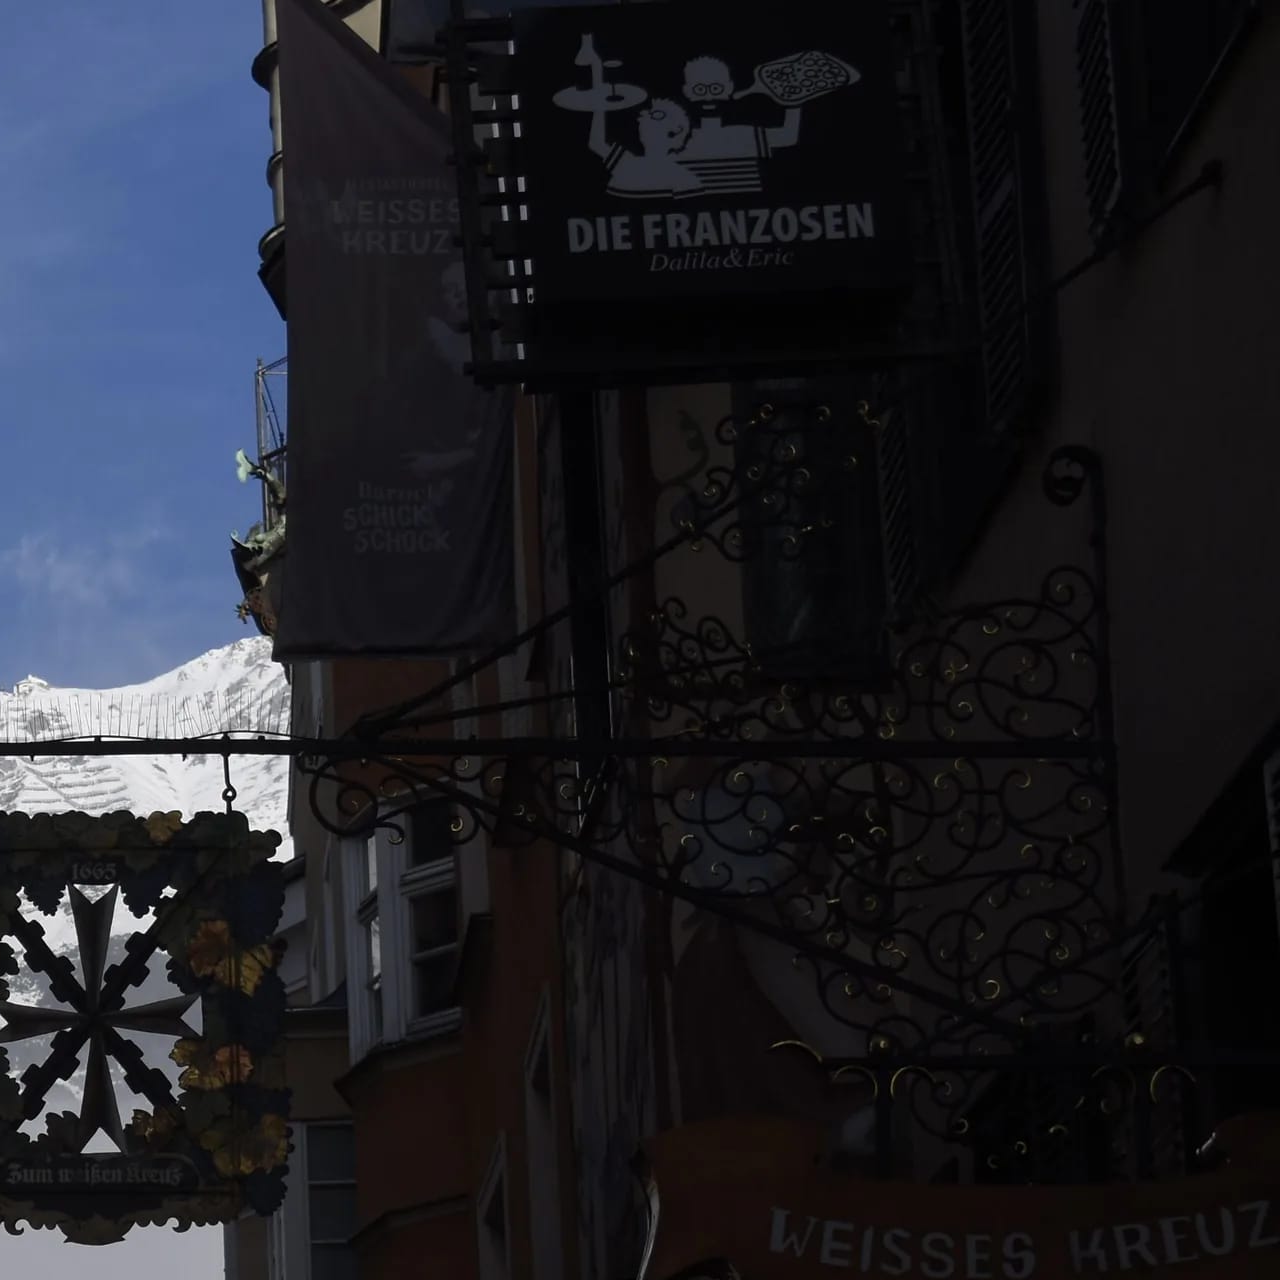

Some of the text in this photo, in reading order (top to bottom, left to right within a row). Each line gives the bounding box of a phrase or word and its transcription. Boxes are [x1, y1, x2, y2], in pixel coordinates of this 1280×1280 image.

[566, 202, 875, 254] DIE FRANZOSEN
[342, 229, 450, 255] KREUZ
[353, 528, 452, 554] SCHOCK
[71, 862, 117, 880] 1665
[6, 1163, 52, 1184] Zum
[767, 1198, 1280, 1280] WEISSES KREUZ
